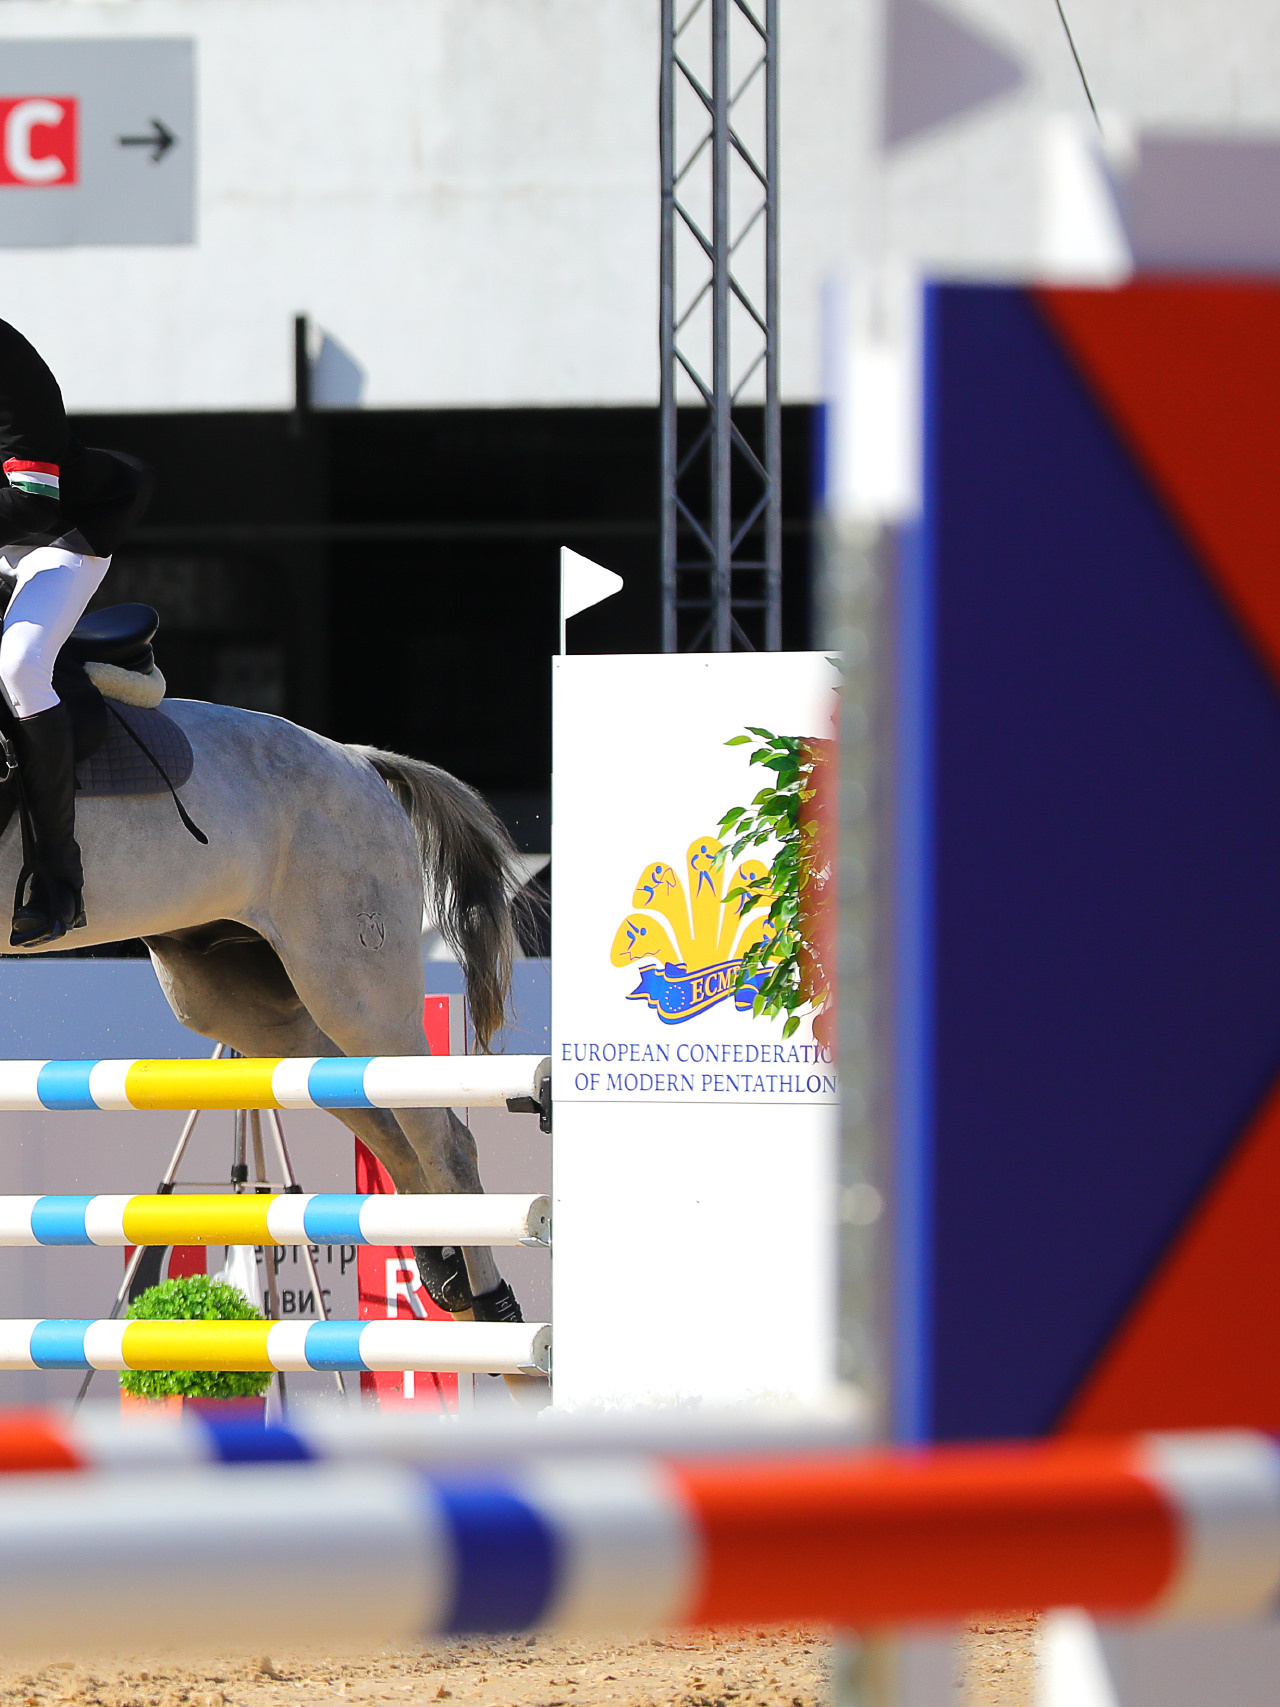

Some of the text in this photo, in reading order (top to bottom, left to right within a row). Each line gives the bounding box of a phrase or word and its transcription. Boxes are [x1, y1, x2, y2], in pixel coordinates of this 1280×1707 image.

[3, 99, 67, 181] C
[561, 1043, 833, 1065] EUROPEAN CONFEDERATIO
[574, 1072, 837, 1093] OF MODERN PENTATHLON
